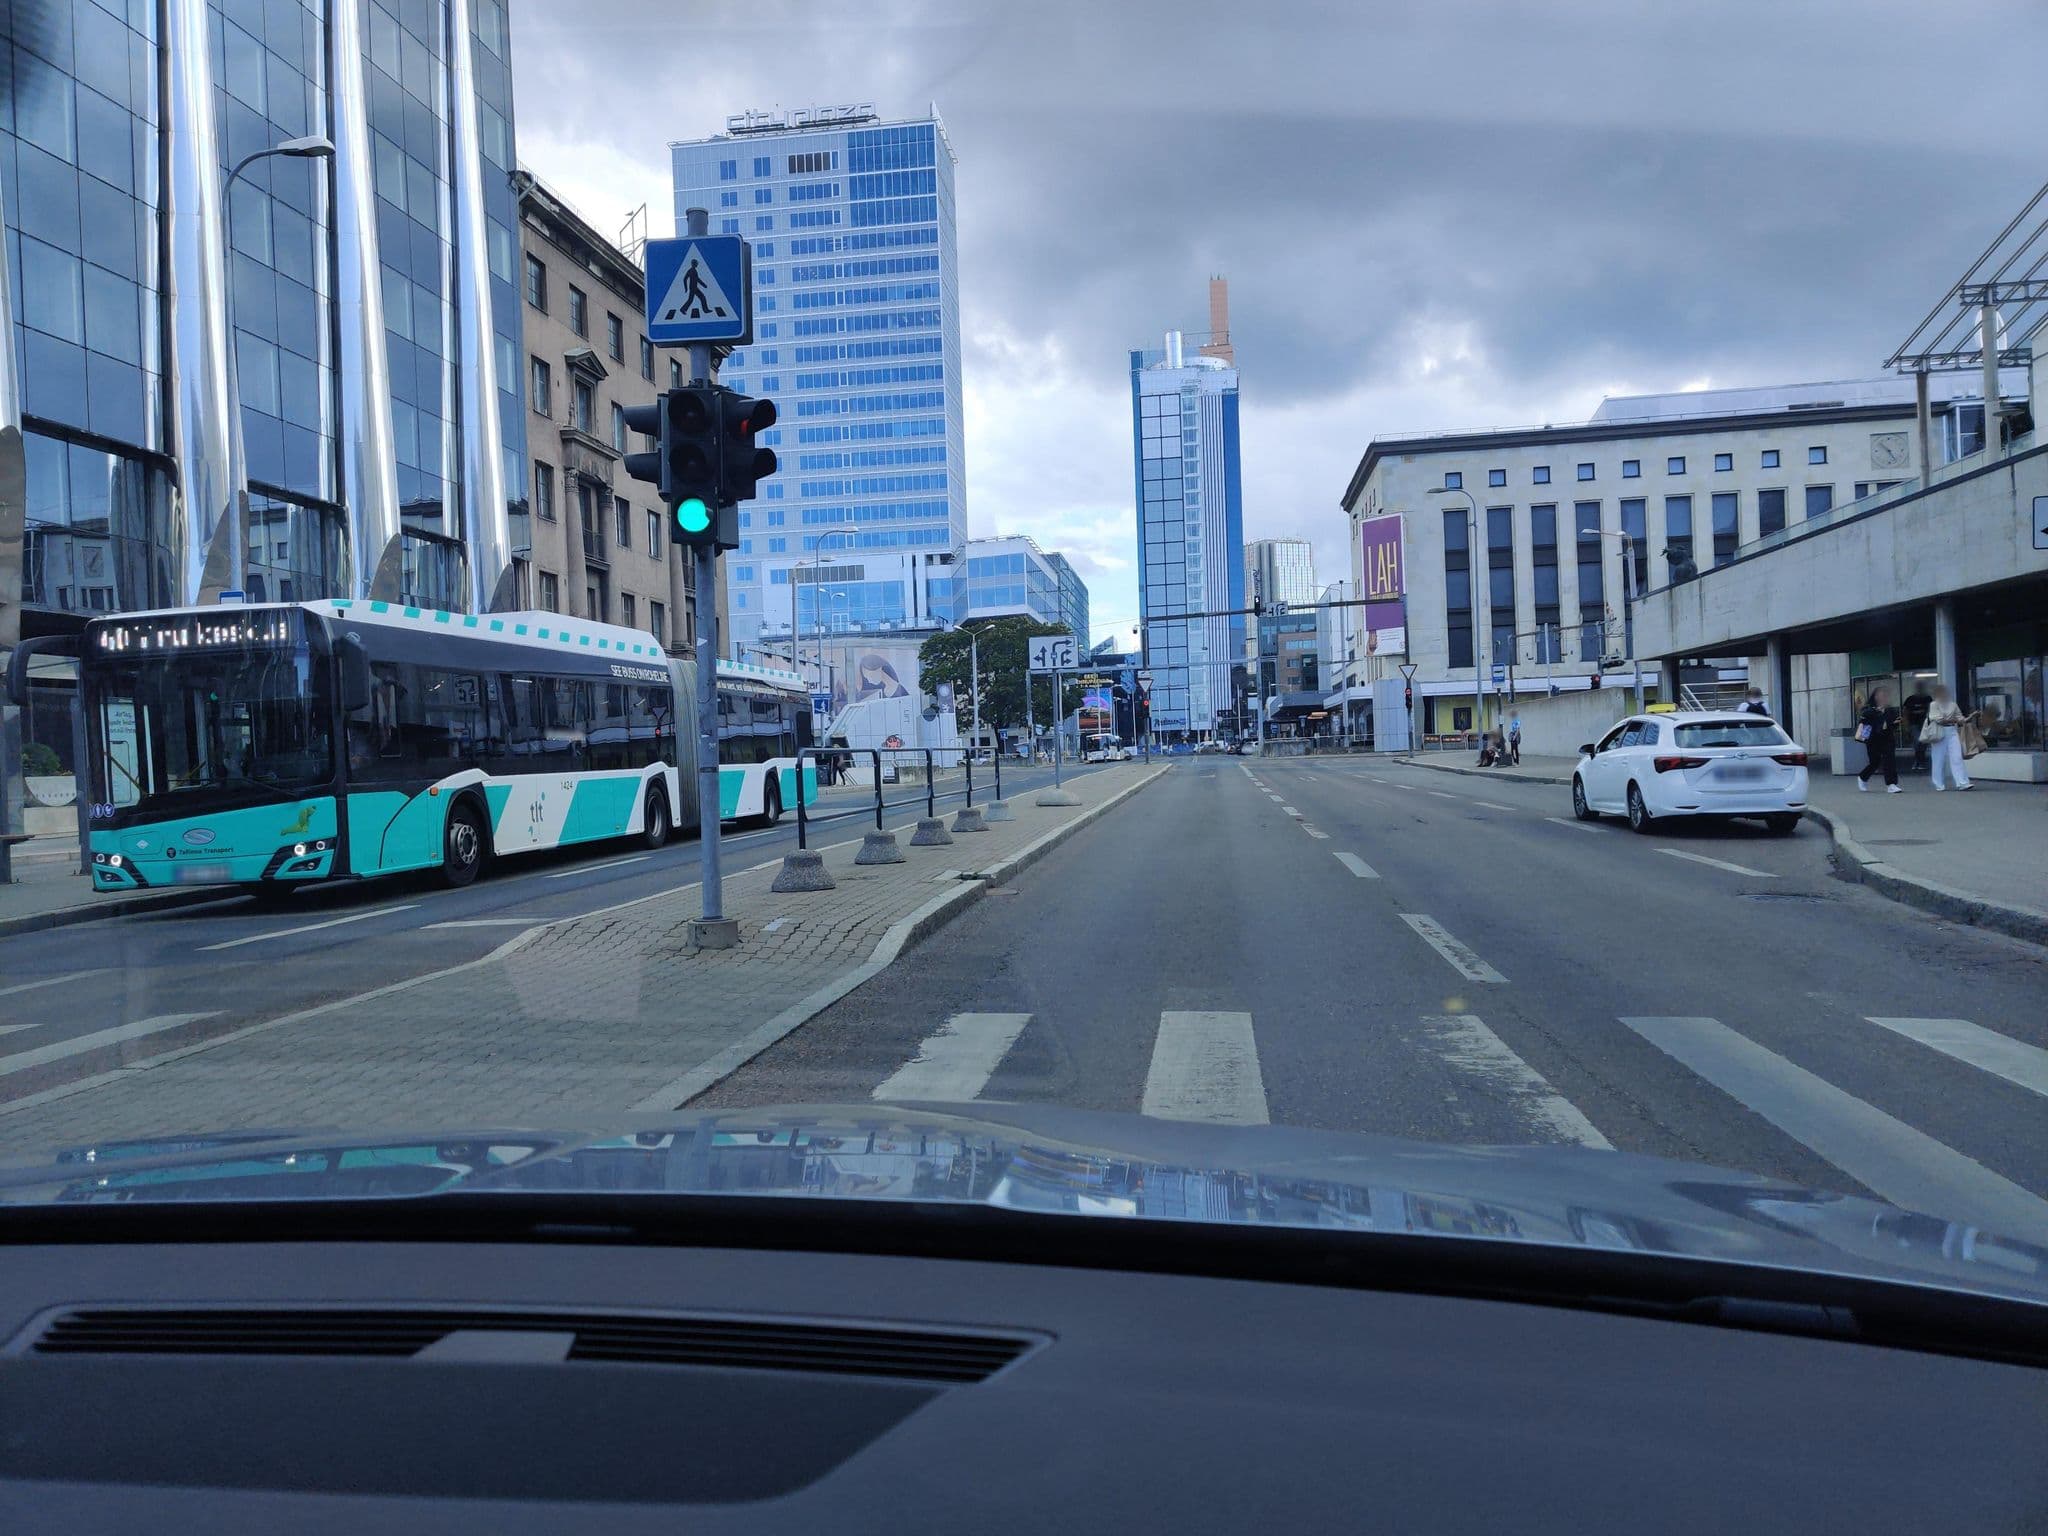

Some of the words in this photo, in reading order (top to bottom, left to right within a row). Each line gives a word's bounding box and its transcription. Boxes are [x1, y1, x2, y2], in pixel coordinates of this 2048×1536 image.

[1368, 541, 1399, 595] LAH!
[561, 780, 573, 790] 1424
[530, 800, 544, 823] tlt
[204, 846, 234, 854] Transport
